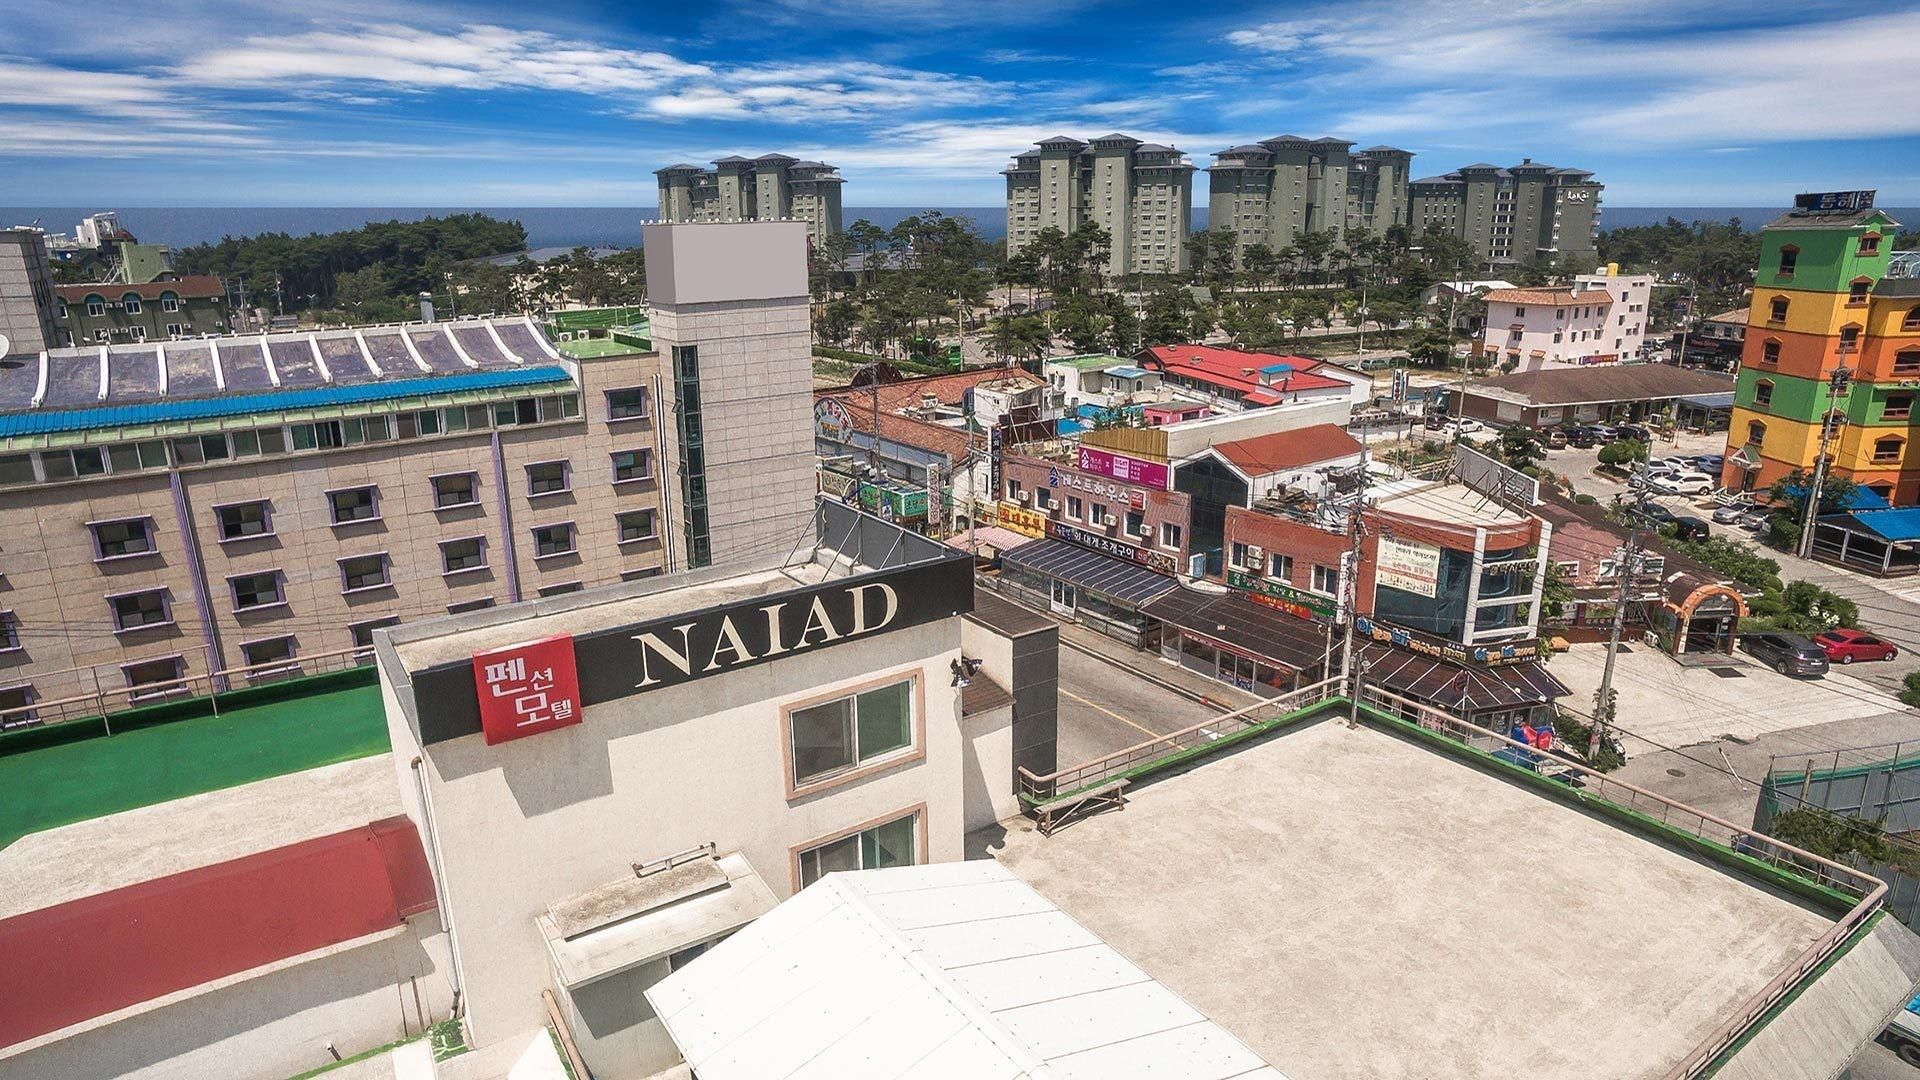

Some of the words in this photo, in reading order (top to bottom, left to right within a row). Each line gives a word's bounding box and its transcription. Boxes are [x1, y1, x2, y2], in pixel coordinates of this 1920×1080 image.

[1061, 472, 1129, 504] 게스트하우스
[629, 582, 898, 689] NAIAD
[484, 657, 554, 697] 펜션
[514, 692, 573, 729] 모텔
